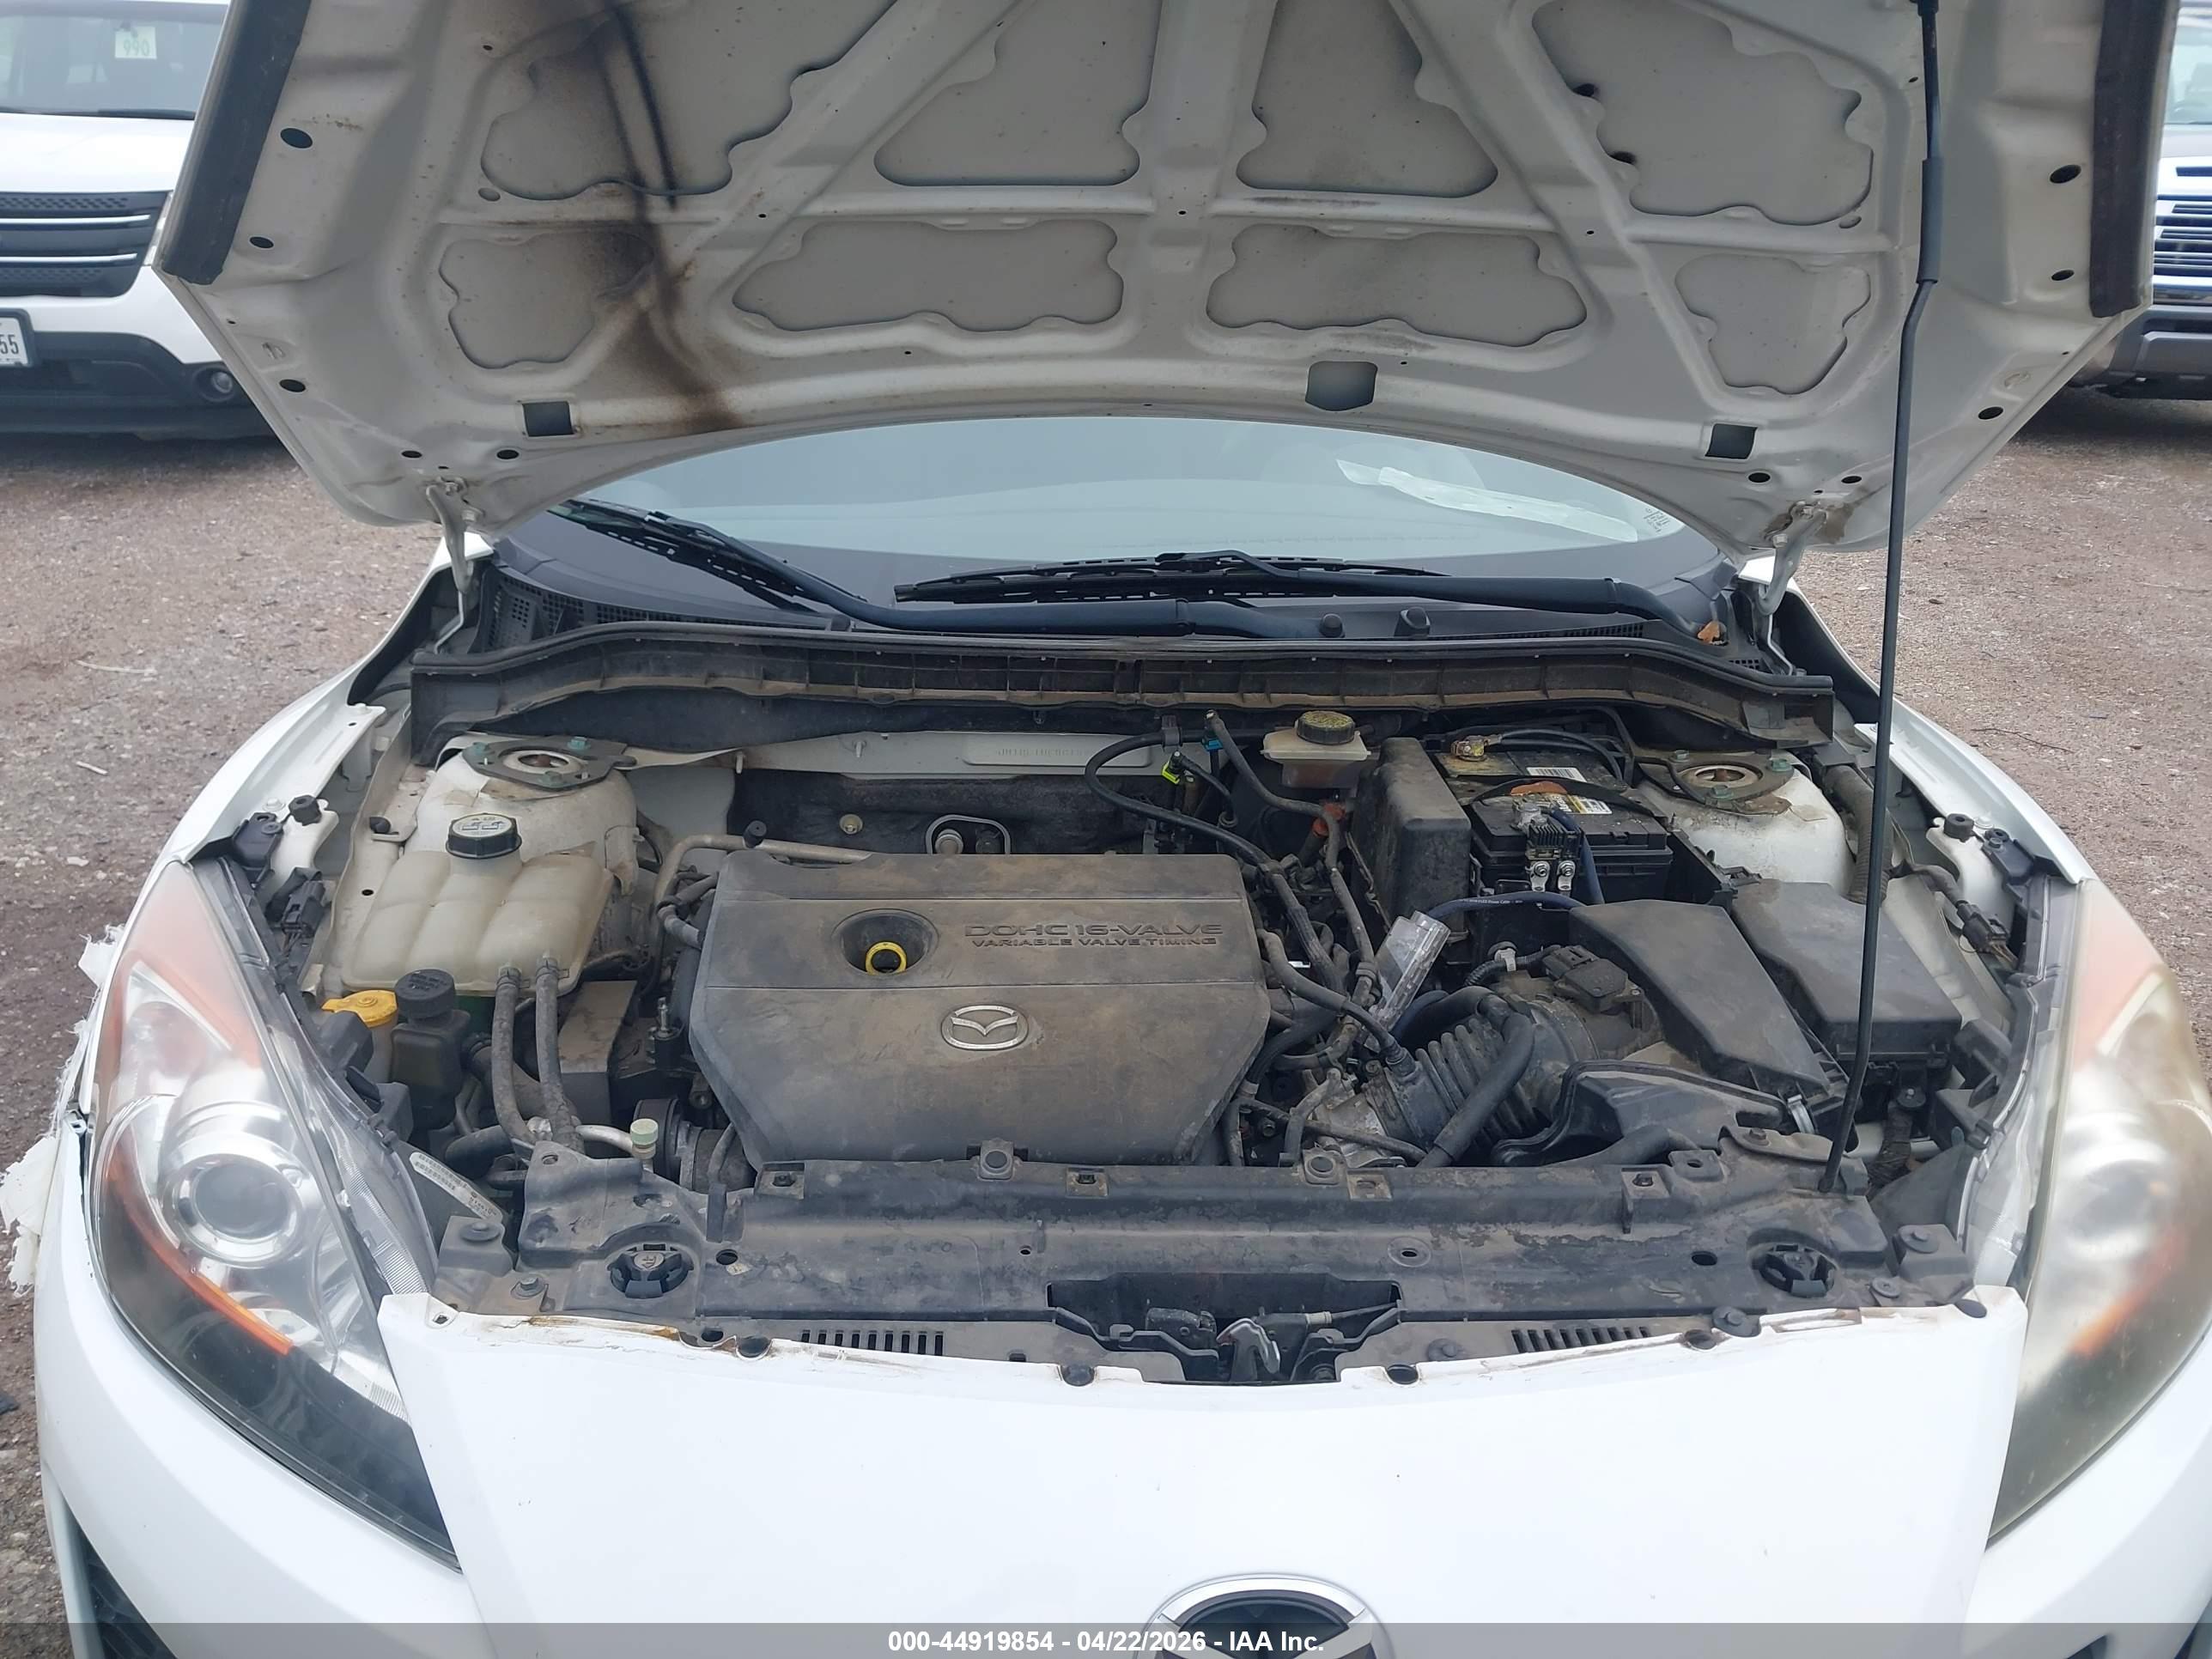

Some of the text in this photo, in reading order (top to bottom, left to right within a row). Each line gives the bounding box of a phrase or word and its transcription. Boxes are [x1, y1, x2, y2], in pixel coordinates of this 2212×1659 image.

[964, 924, 1224, 937] DOHC 16-VALVE
[971, 939, 1073, 947] VARIABLE
[1078, 938, 1141, 946] VALVE
